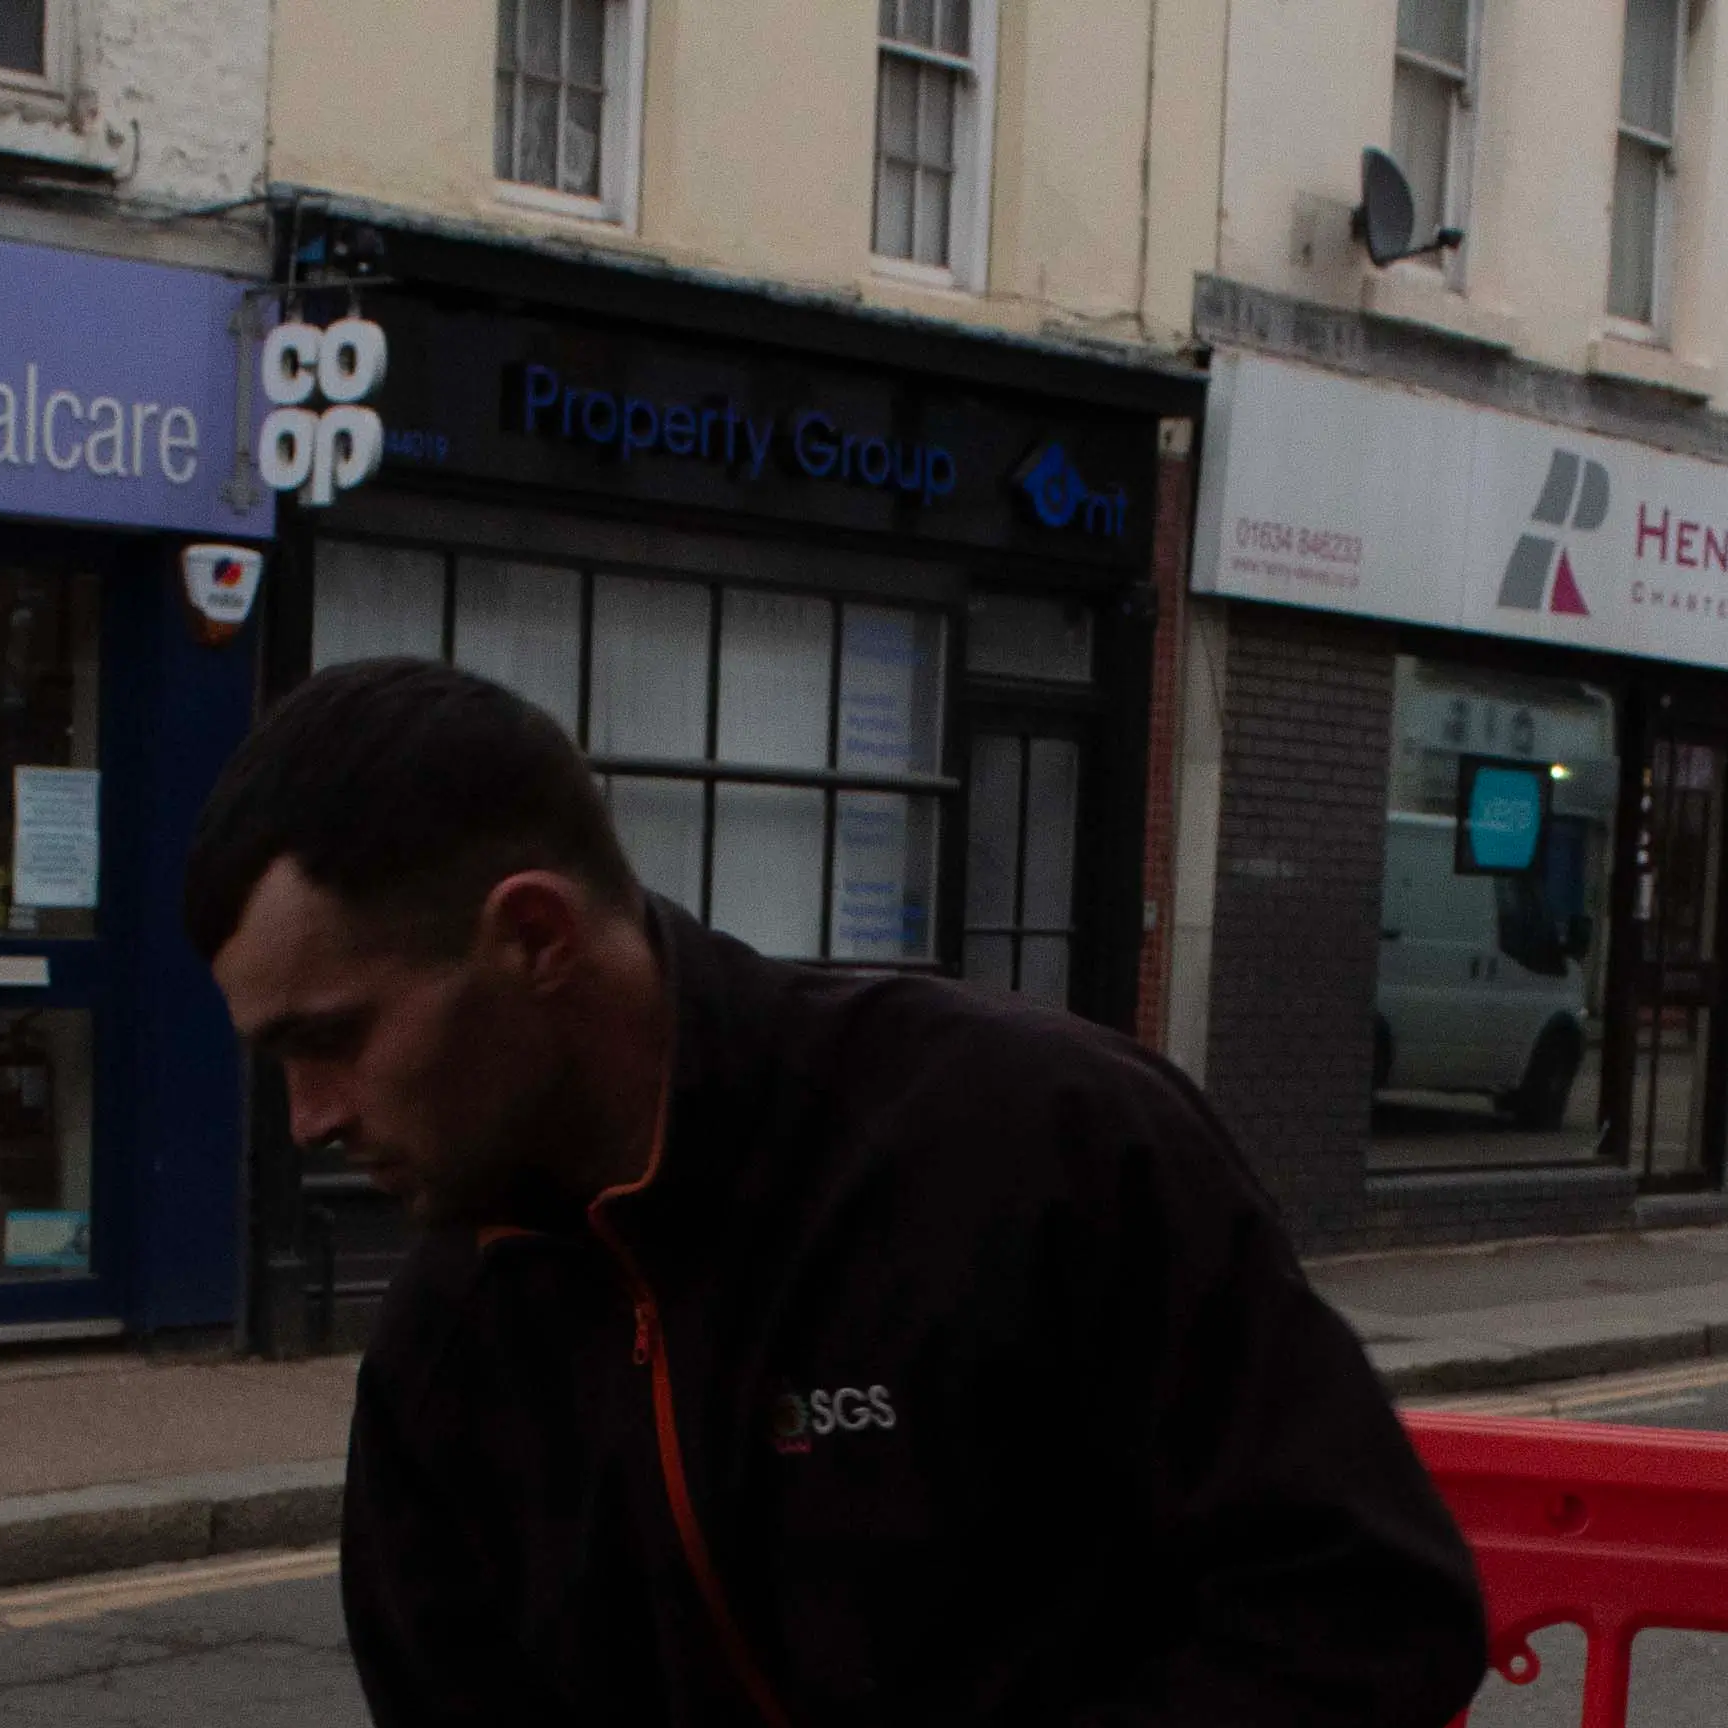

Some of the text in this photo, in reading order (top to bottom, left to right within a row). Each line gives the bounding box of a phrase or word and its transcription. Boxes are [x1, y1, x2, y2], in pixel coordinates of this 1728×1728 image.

[261, 318, 389, 405] co
[258, 404, 386, 509] op
[524, 363, 959, 506] Property Group
[809, 1384, 897, 1436] SGS
